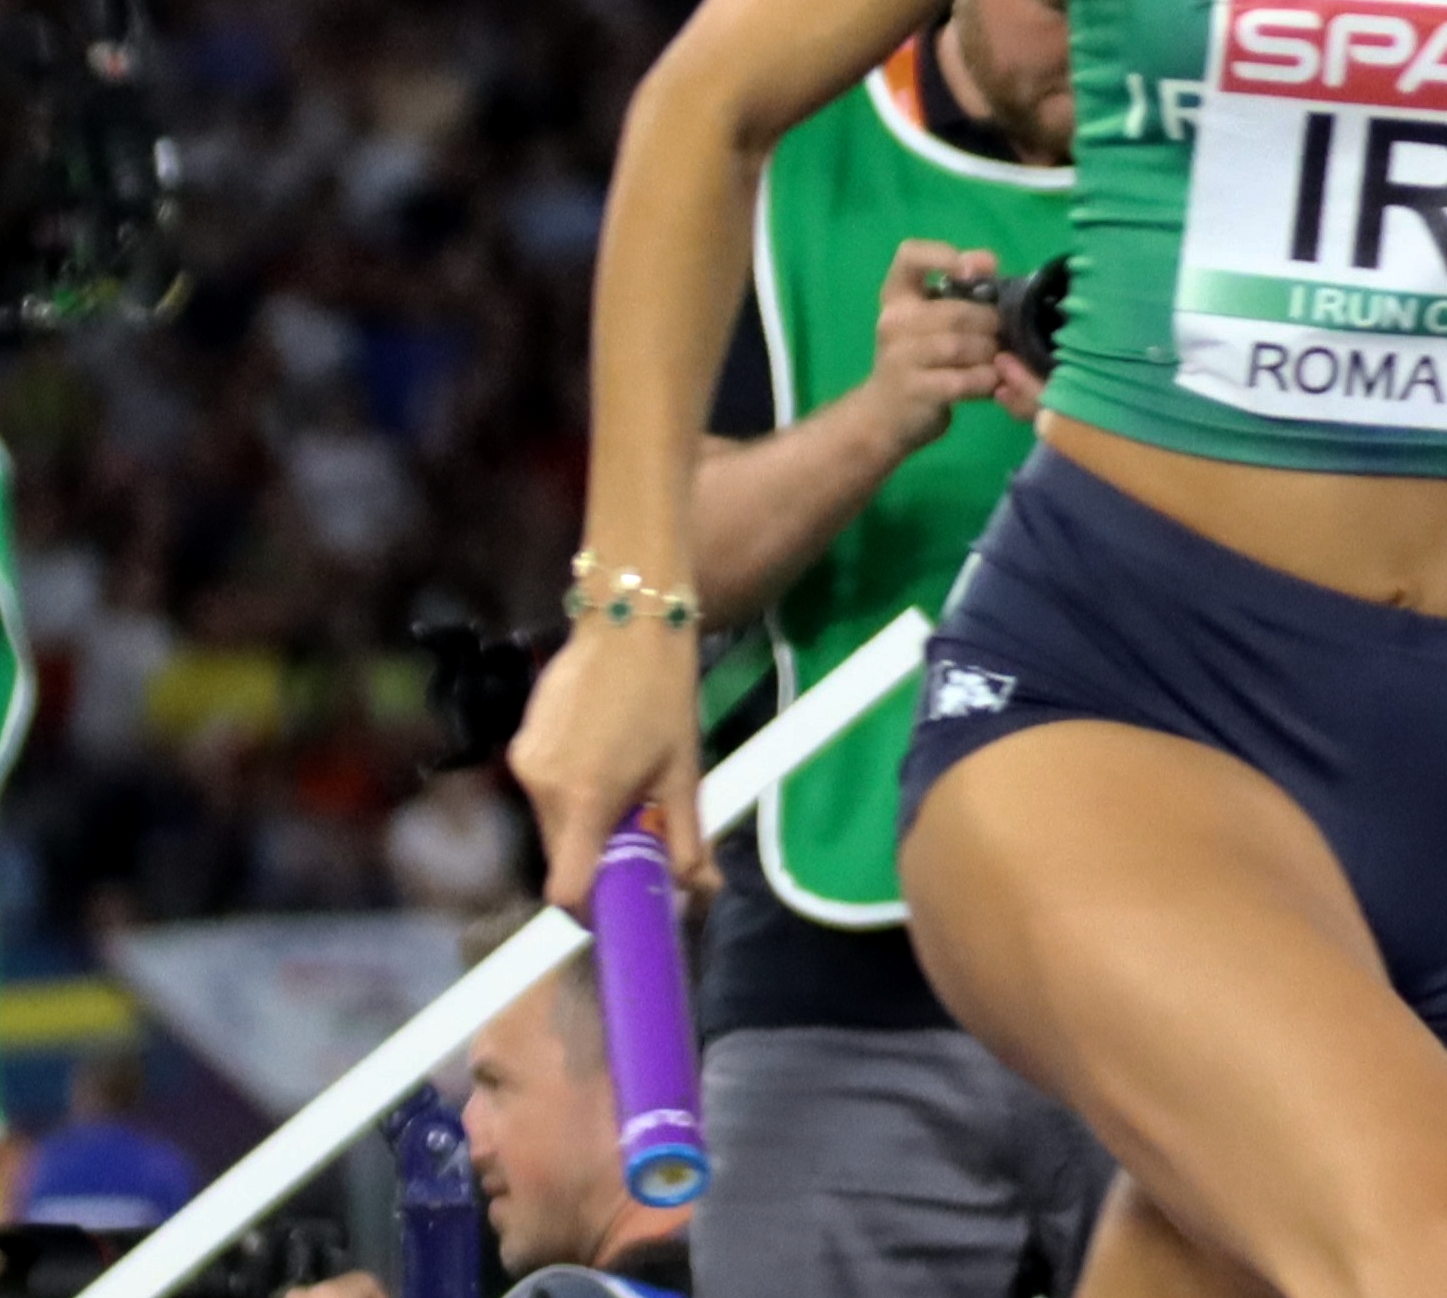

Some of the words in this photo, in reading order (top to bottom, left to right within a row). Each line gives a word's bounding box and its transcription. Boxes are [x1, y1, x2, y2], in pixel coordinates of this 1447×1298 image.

[1288, 286, 1305, 318] I
[1312, 287, 1415, 331] RUN
[1248, 342, 1446, 403] ROMA
